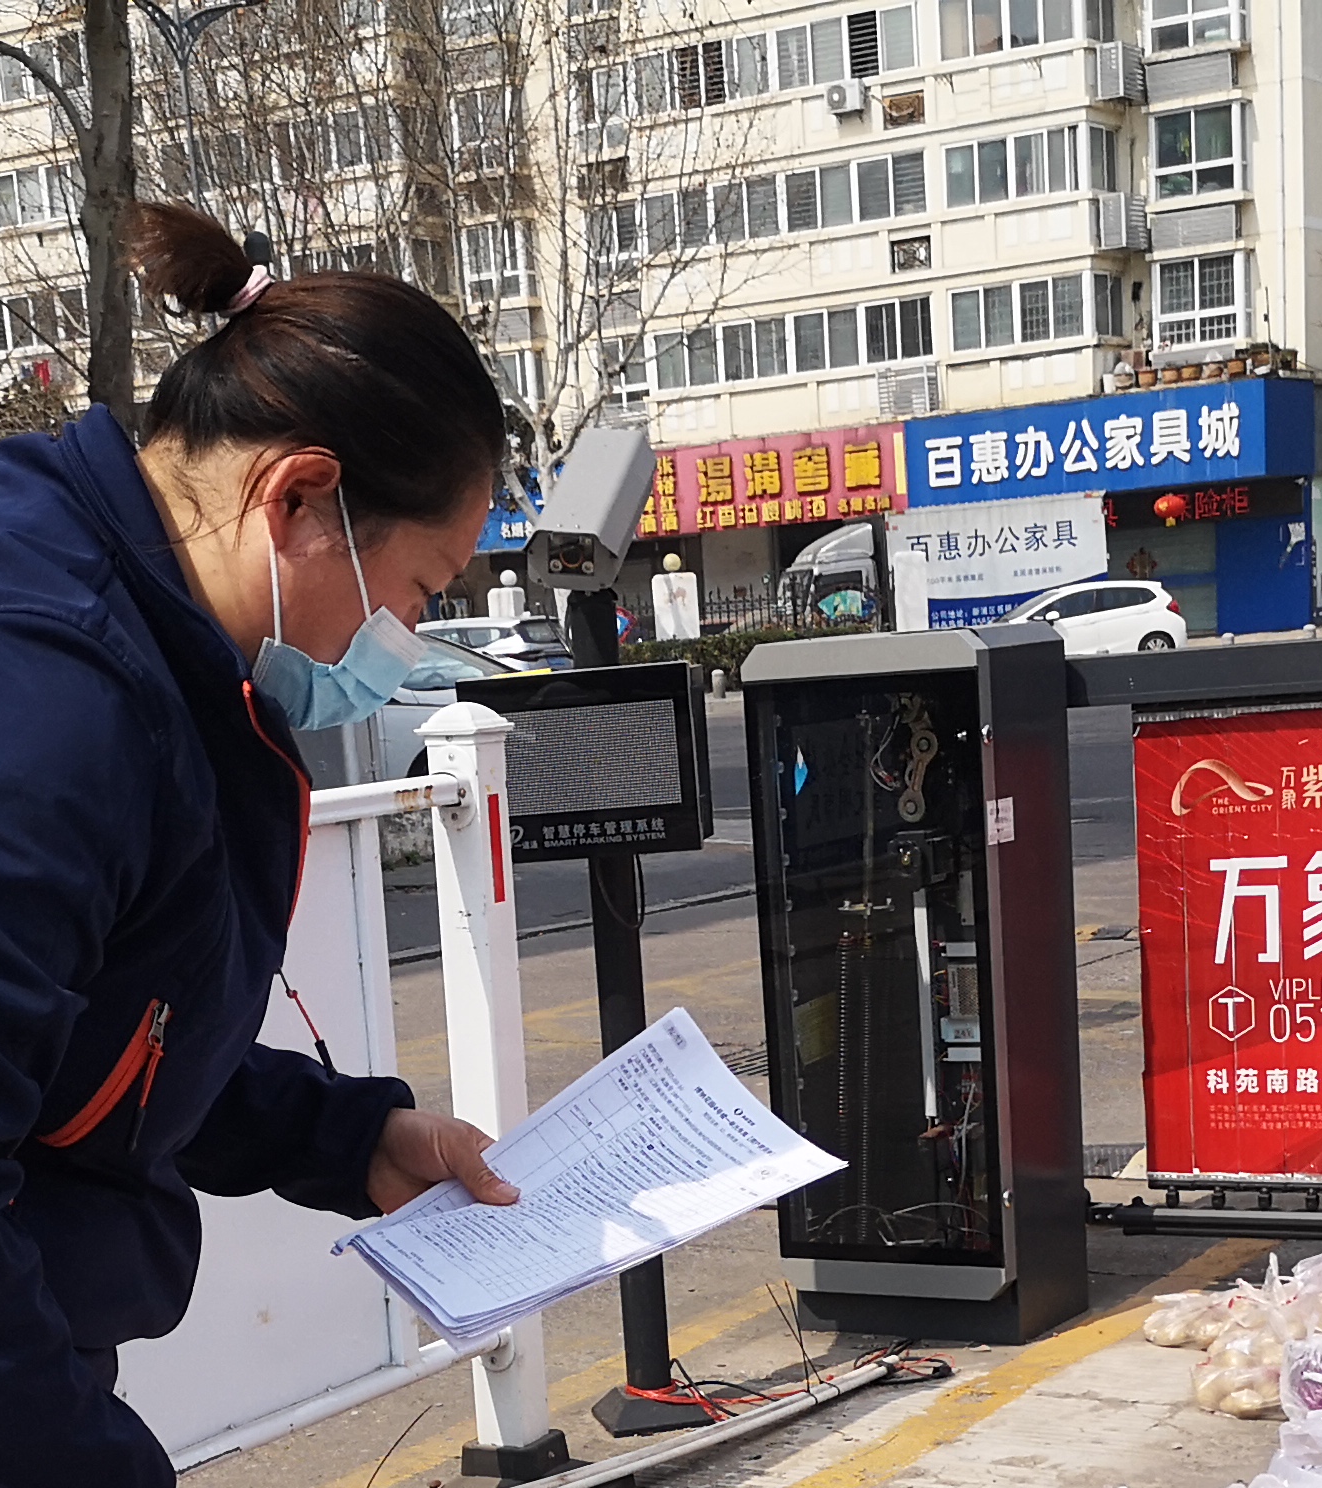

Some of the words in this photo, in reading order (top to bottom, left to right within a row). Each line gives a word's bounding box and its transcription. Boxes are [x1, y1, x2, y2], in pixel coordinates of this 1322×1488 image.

[925, 401, 1241, 489] 百惠办公家具城
[906, 519, 1078, 562] 百惠办公家具
[1280, 766, 1297, 811] 万象
[1211, 804, 1247, 815] ORIENT
[1250, 803, 1274, 814] CITY
[542, 817, 665, 840] 智慧停车管理系统
[543, 838, 578, 849] SMART
[579, 834, 623, 846] PARKING
[625, 831, 667, 842] SYSTEM
